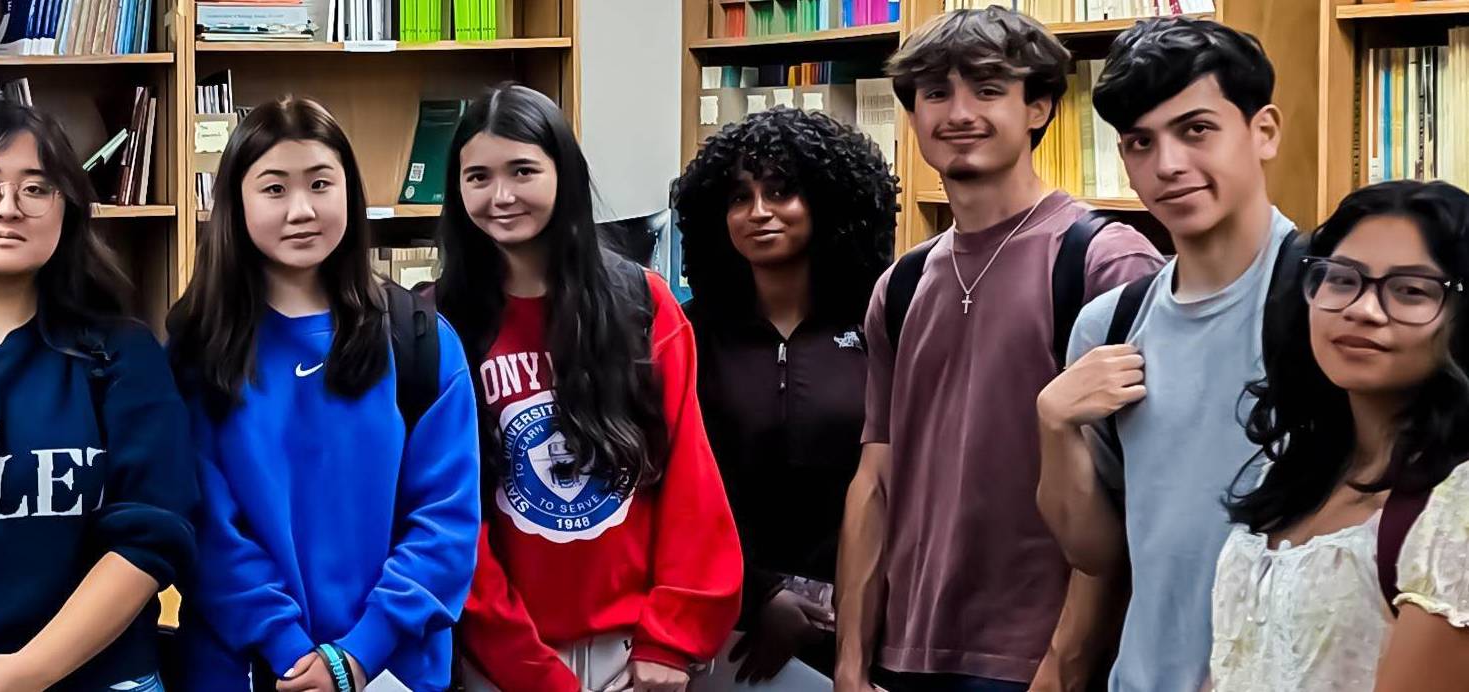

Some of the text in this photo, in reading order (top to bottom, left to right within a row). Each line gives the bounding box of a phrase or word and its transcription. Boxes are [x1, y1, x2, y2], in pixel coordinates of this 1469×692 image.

[480, 351, 542, 405] ONY
[504, 403, 555, 460] UNIVERSIT
[515, 424, 545, 477] TO LEARN
[539, 494, 600, 514] TO SERVE
[556, 516, 590, 530] 1948
